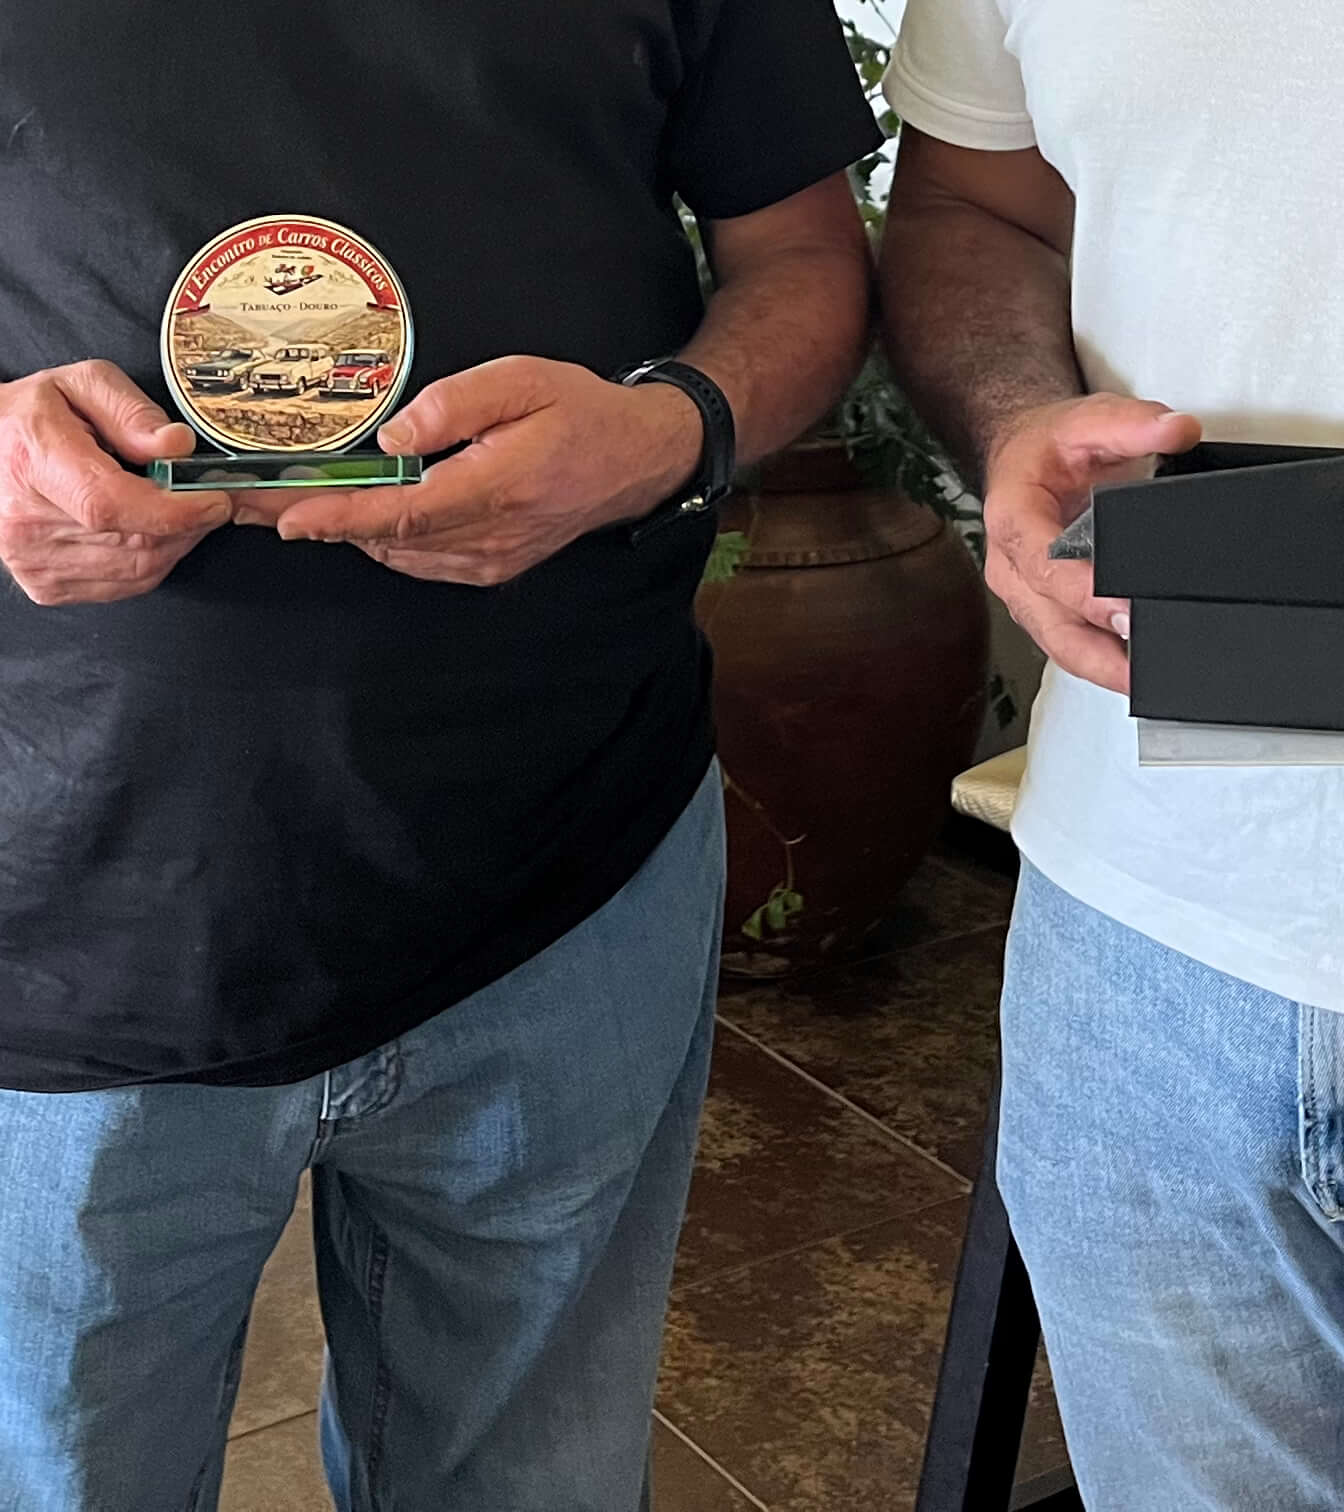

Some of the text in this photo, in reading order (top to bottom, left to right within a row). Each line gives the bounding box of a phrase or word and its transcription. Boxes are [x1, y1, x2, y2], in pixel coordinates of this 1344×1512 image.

[195, 238, 255, 284] Encontro
[277, 228, 328, 248] Carros
[240, 302, 338, 312] TABUAÇO DOURO
